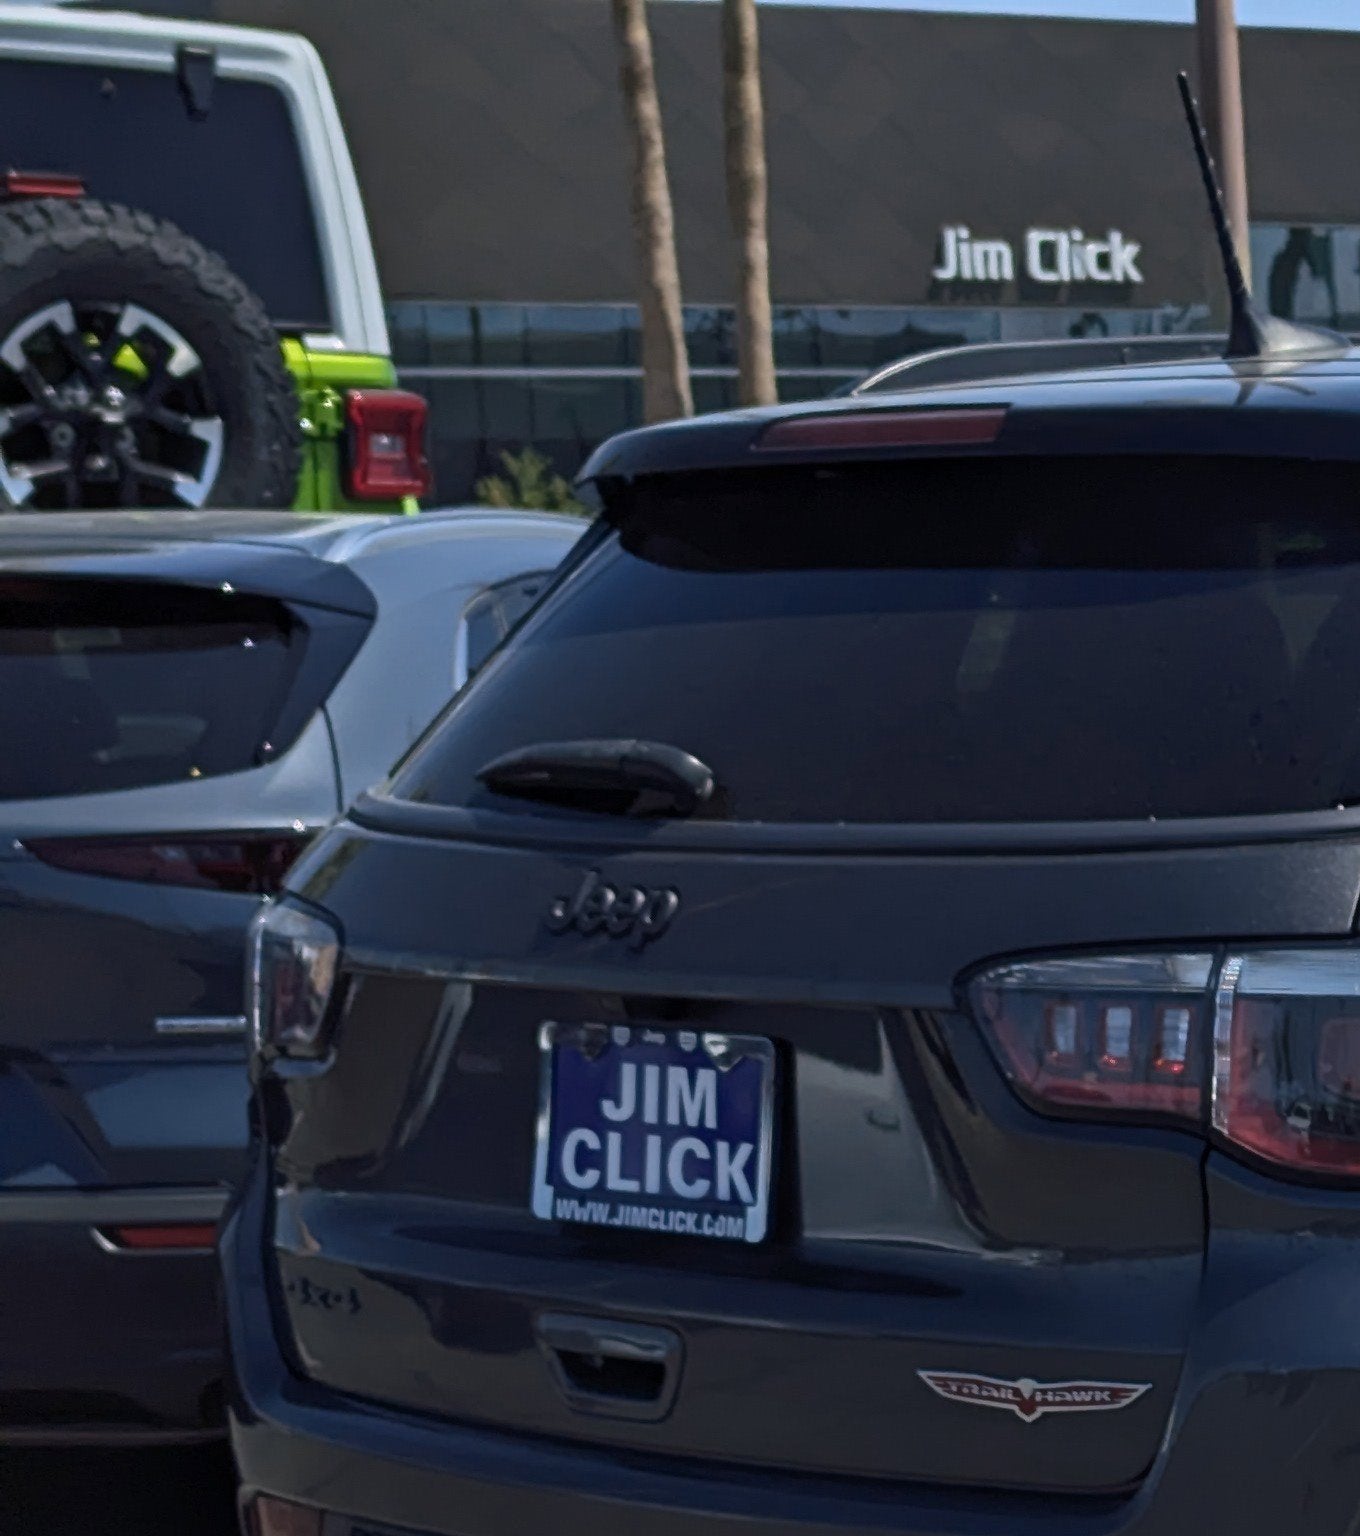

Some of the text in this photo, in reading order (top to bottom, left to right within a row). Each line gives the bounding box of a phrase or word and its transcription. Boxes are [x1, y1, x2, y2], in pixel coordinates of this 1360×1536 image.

[931, 226, 1144, 282] Jim Click
[551, 870, 680, 953] Jeep
[600, 1062, 718, 1129] JIM
[561, 1127, 755, 1204] CLICK
